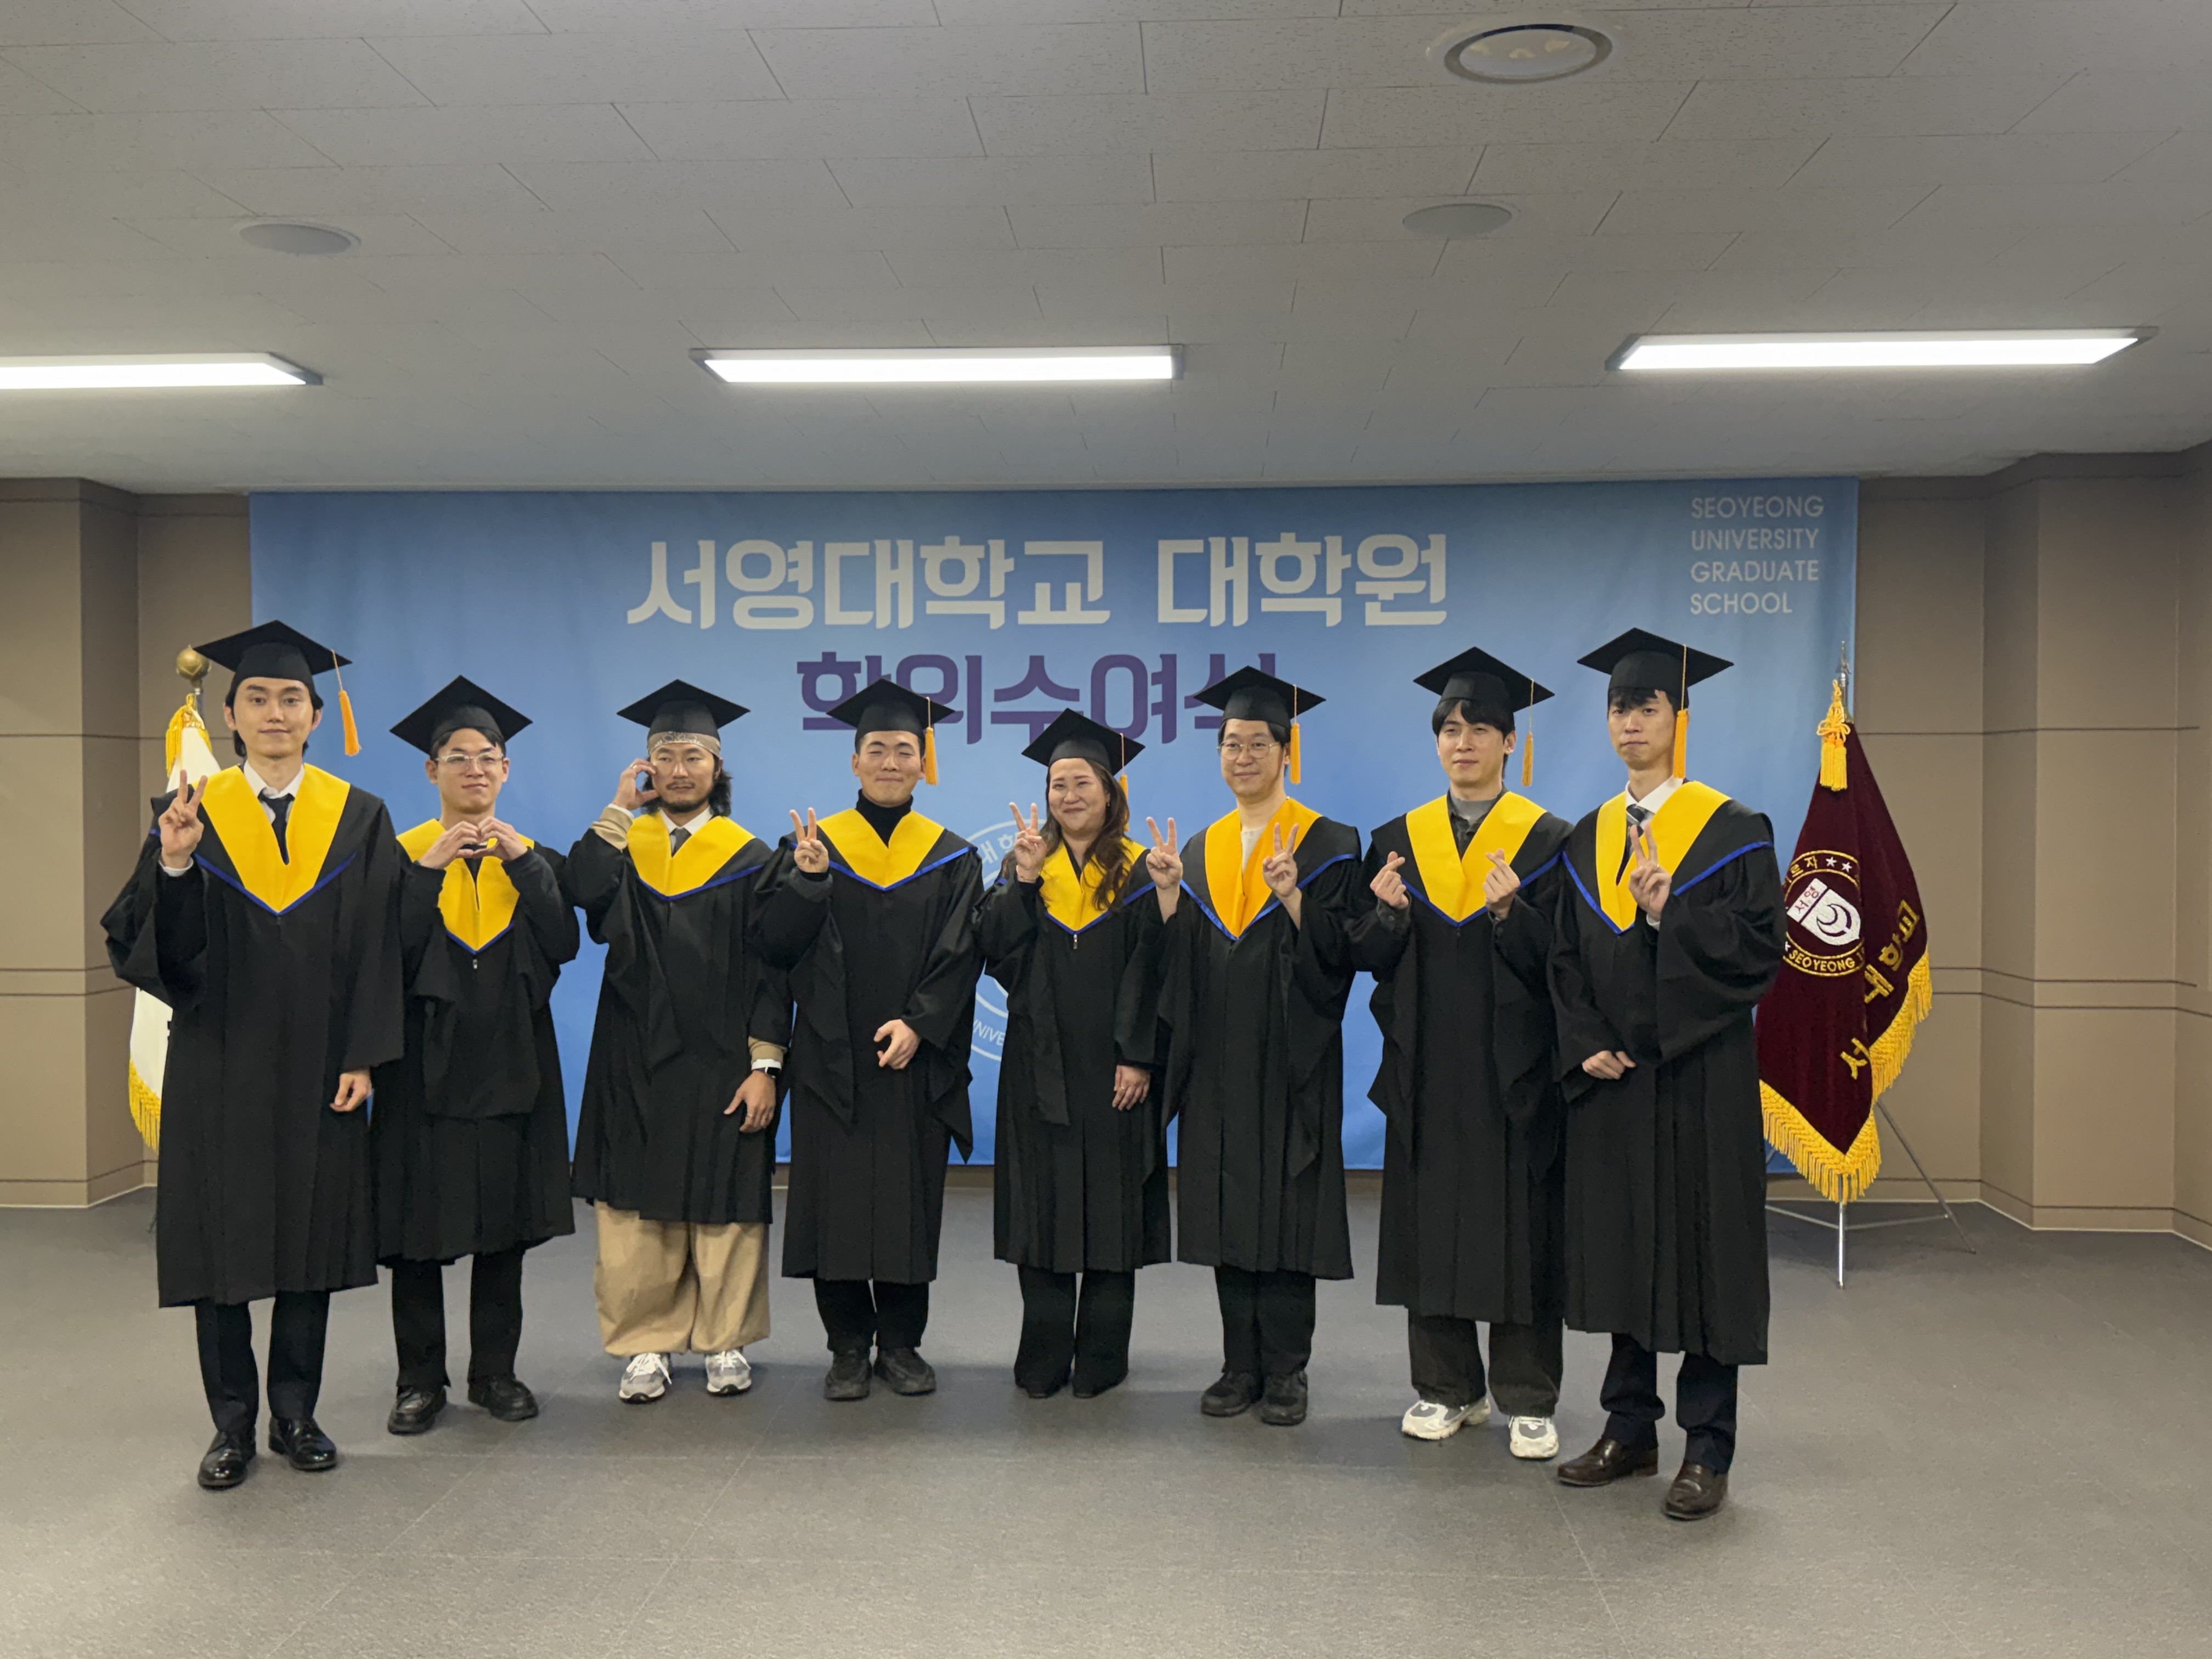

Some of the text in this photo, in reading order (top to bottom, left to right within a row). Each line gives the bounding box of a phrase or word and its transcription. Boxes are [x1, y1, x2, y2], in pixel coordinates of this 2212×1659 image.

[1691, 495, 1825, 518] SEOYEONG
[1691, 528, 1819, 551] UNIVERSITY
[627, 532, 1447, 630] 서영대학교 대학원
[1690, 560, 1820, 583] GRADUATE
[1690, 592, 1793, 615] SCHOOL
[1795, 884, 1820, 915] 서영
[1788, 949, 1855, 972] SEOYEONG
